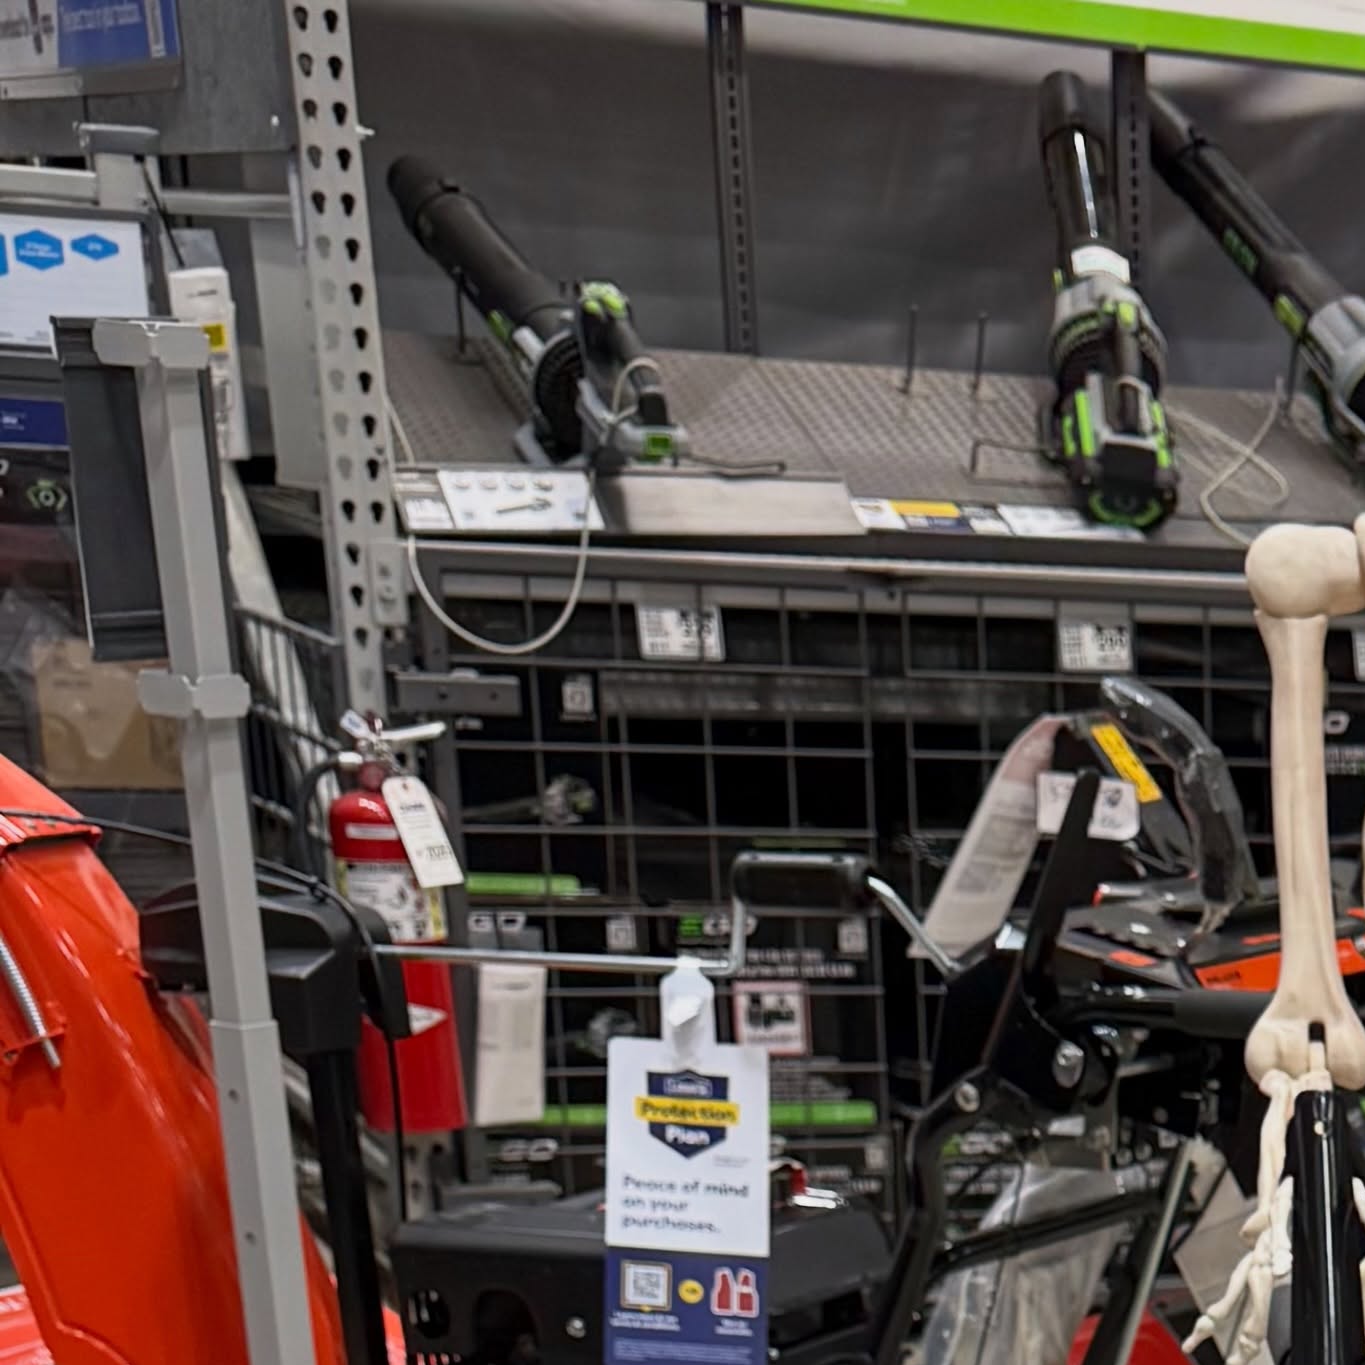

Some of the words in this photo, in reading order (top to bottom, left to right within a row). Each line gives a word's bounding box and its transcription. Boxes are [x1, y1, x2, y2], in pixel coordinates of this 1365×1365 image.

[639, 1101, 736, 1122] Protection
[665, 1126, 710, 1144] Plan
[623, 1175, 676, 1192] Peace
[683, 1176, 700, 1192] of
[703, 1182, 749, 1198] mind
[624, 1198, 645, 1209] on
[651, 1200, 688, 1213] your
